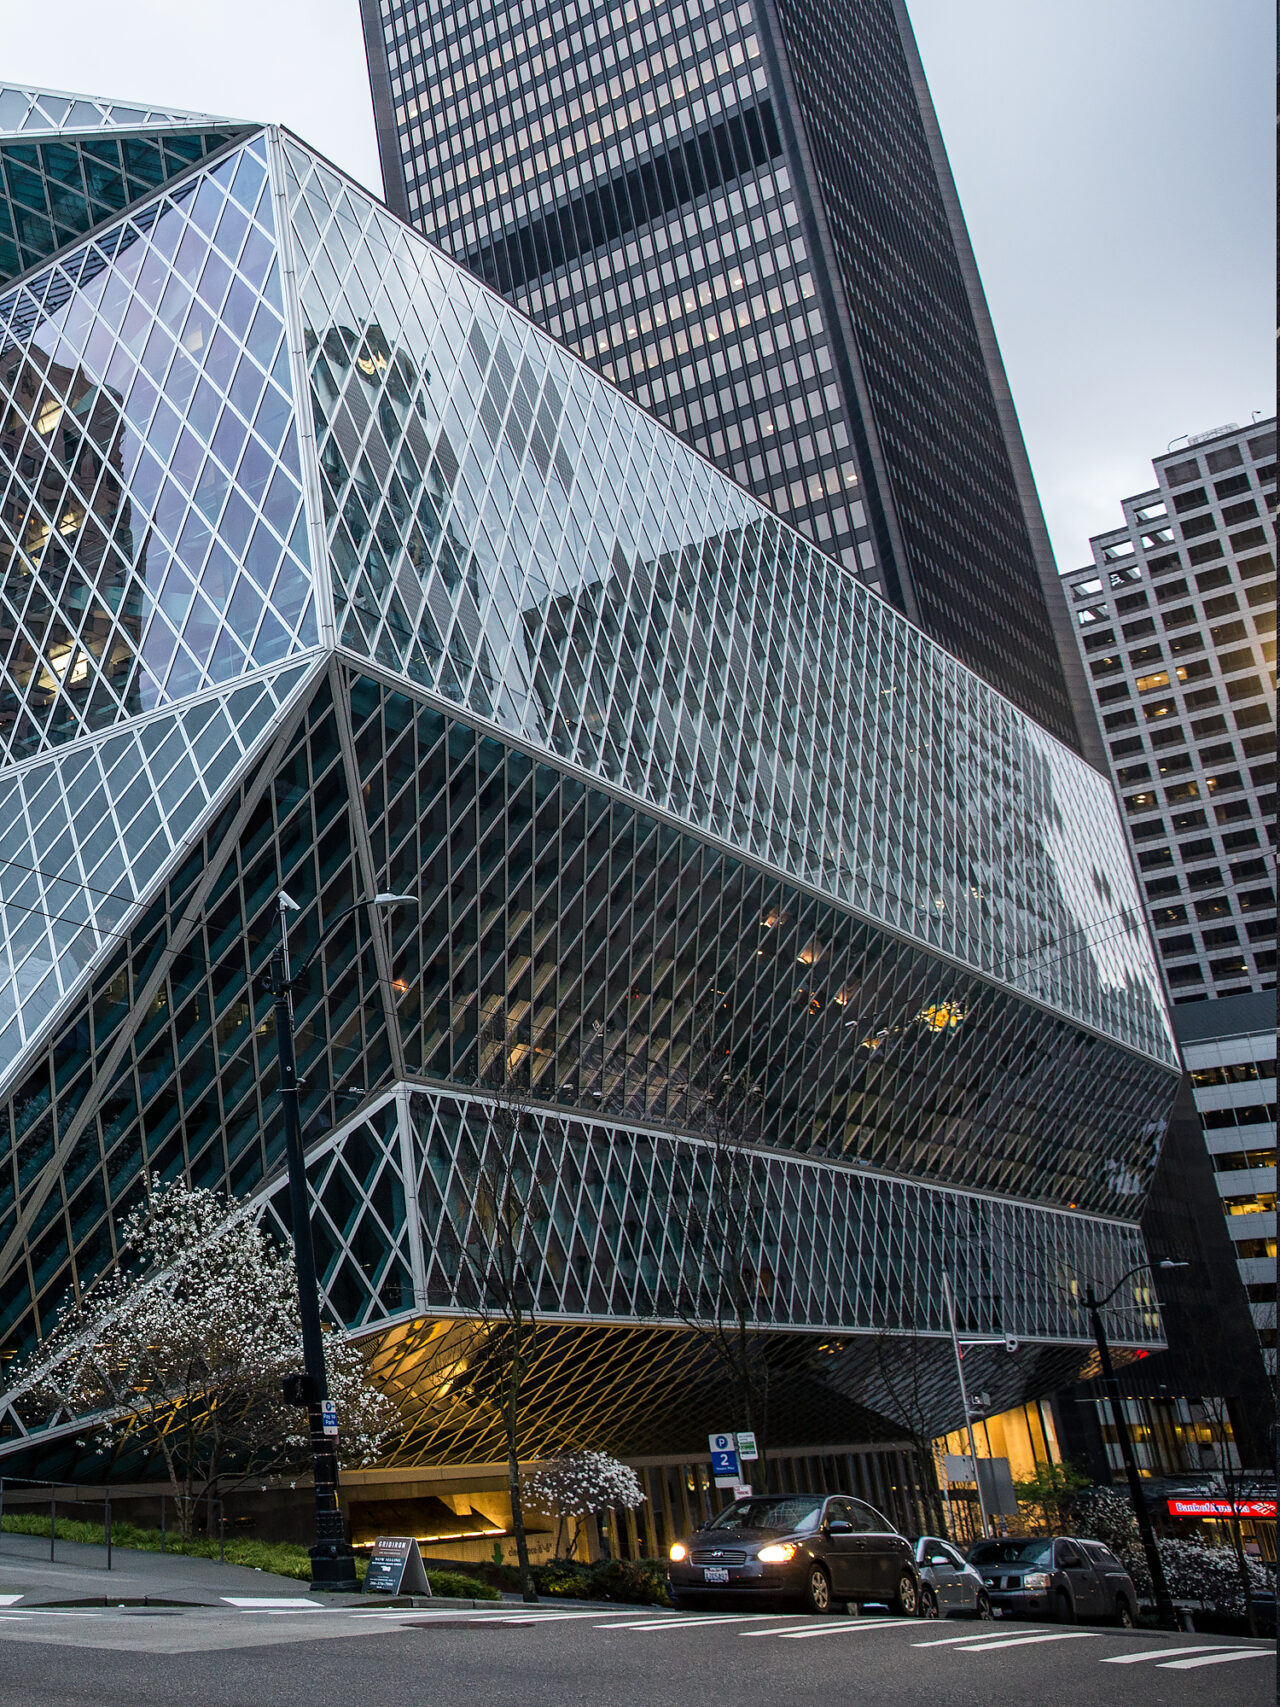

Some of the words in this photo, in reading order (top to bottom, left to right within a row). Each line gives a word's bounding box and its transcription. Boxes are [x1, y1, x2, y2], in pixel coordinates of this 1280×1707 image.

[718, 1438, 726, 1447] P
[720, 1453, 729, 1466] 2
[1175, 1502, 1199, 1512] Bank
[1200, 1502, 1210, 1512] of
[378, 1540, 407, 1549] GRIDIRON
